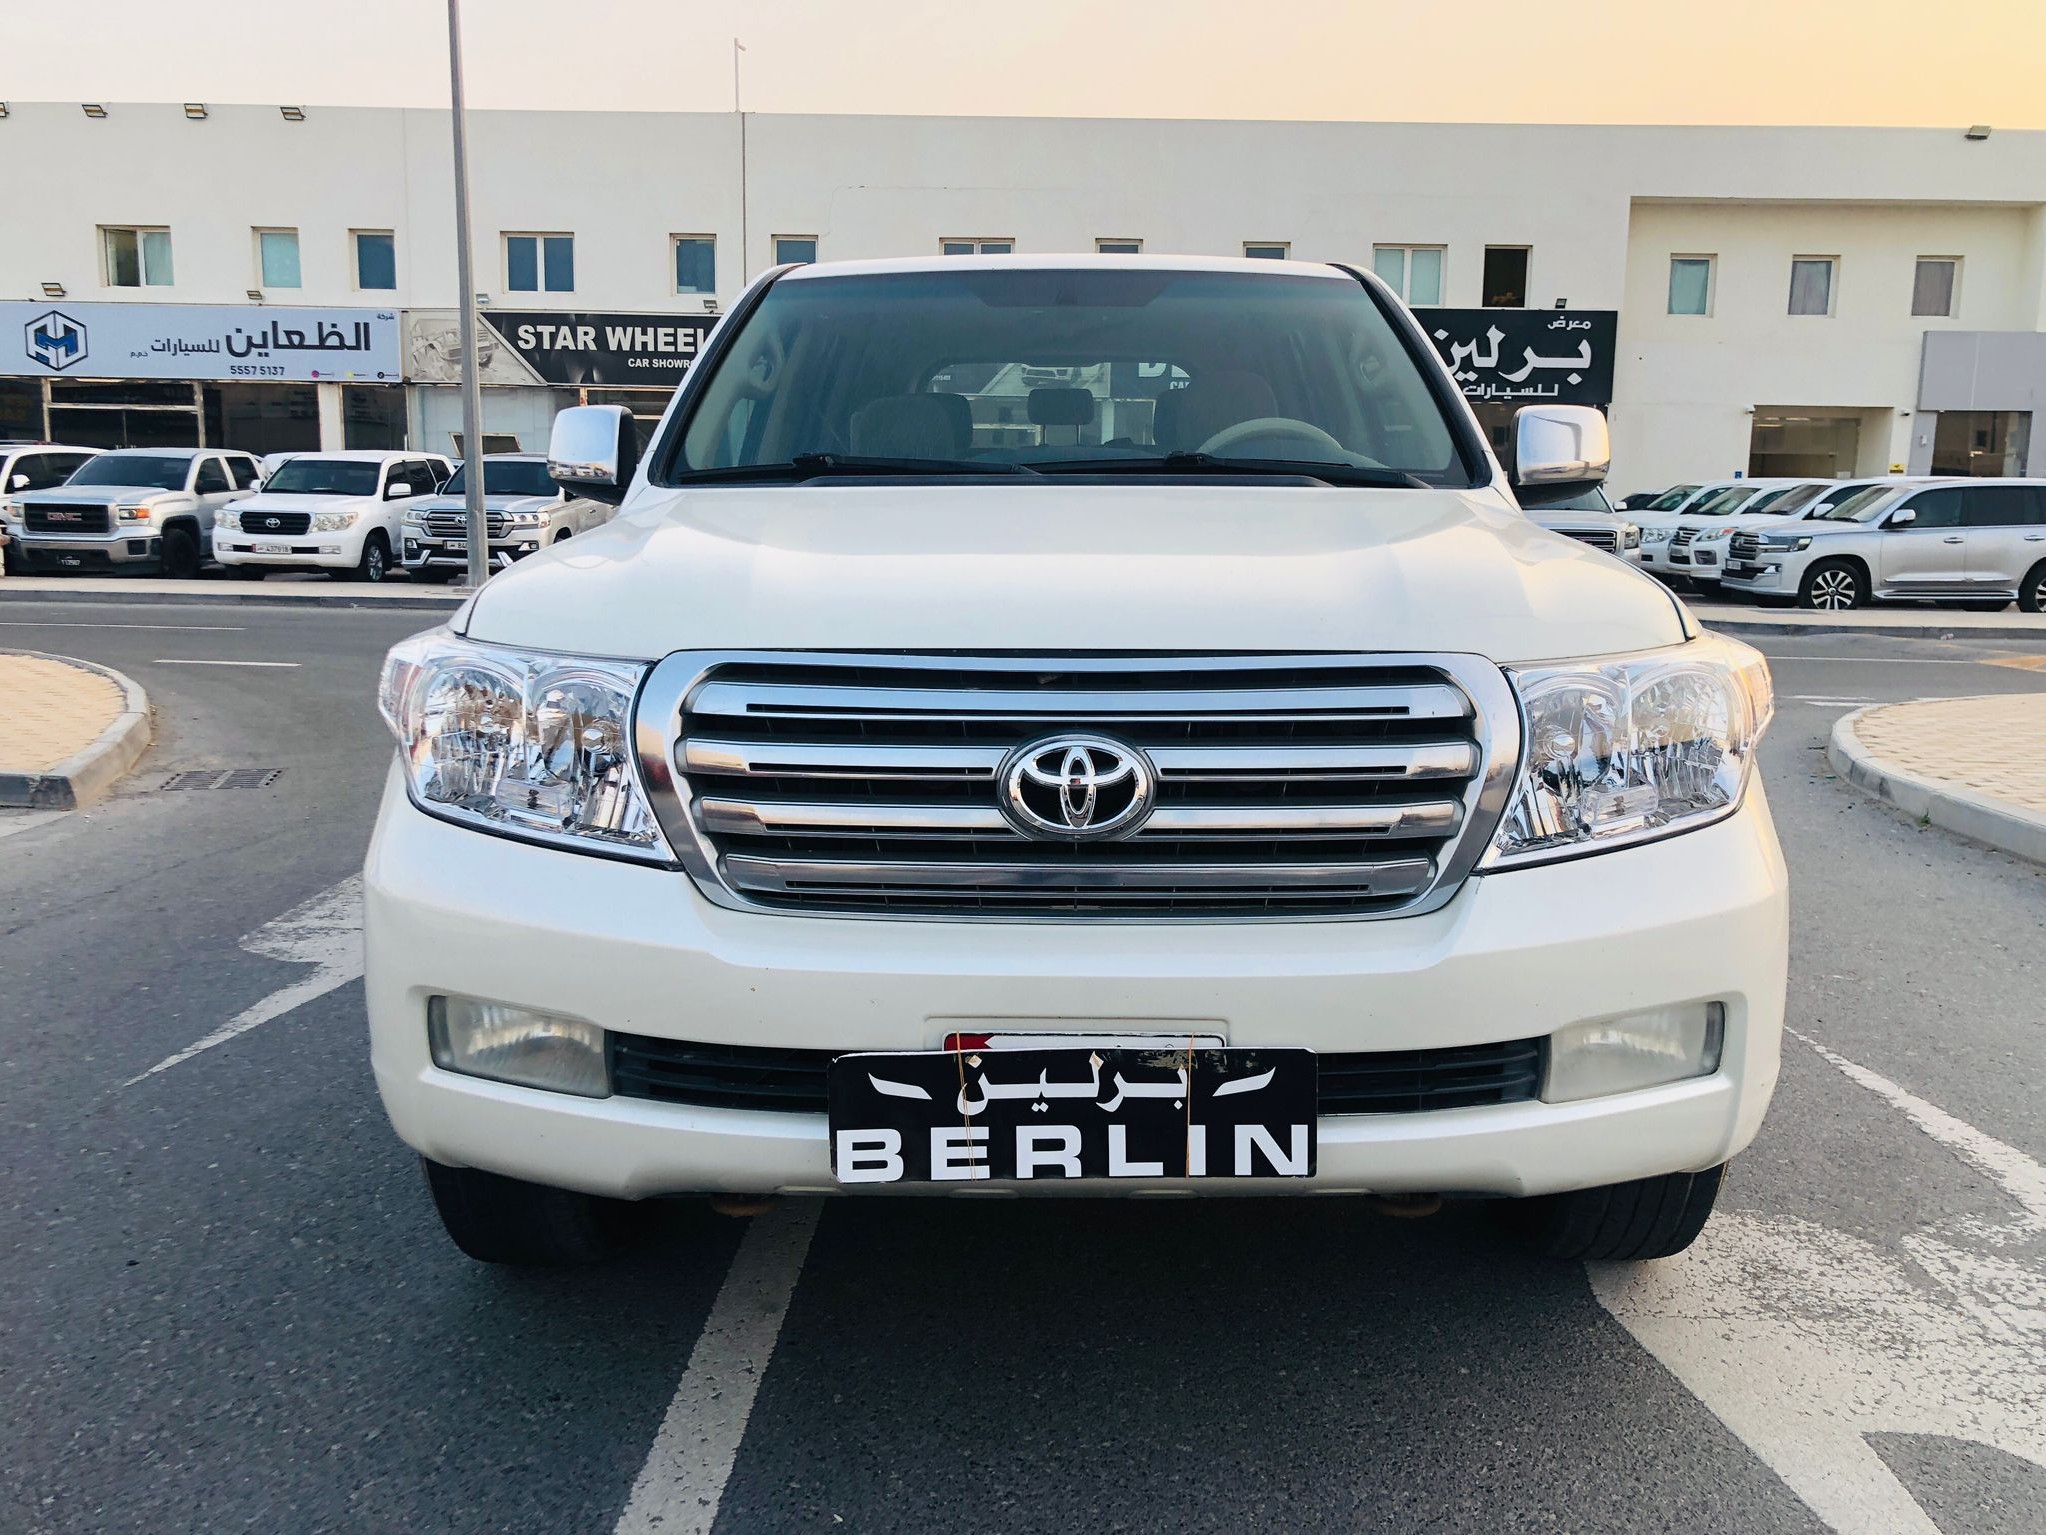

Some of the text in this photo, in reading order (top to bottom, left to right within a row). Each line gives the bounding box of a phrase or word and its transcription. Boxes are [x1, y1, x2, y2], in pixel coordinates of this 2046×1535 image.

[1547, 315, 1592, 330] معرض
[225, 320, 371, 358] الظعاين
[517, 324, 598, 351] STAR
[150, 338, 220, 356] للسيارات
[230, 365, 285, 376] 5557 5137
[627, 358, 693, 369] CAR SHOWR
[1462, 383, 1559, 400] للسيارات
[956, 1051, 1188, 1116] برلين
[836, 1124, 1309, 1184] BERLIN
